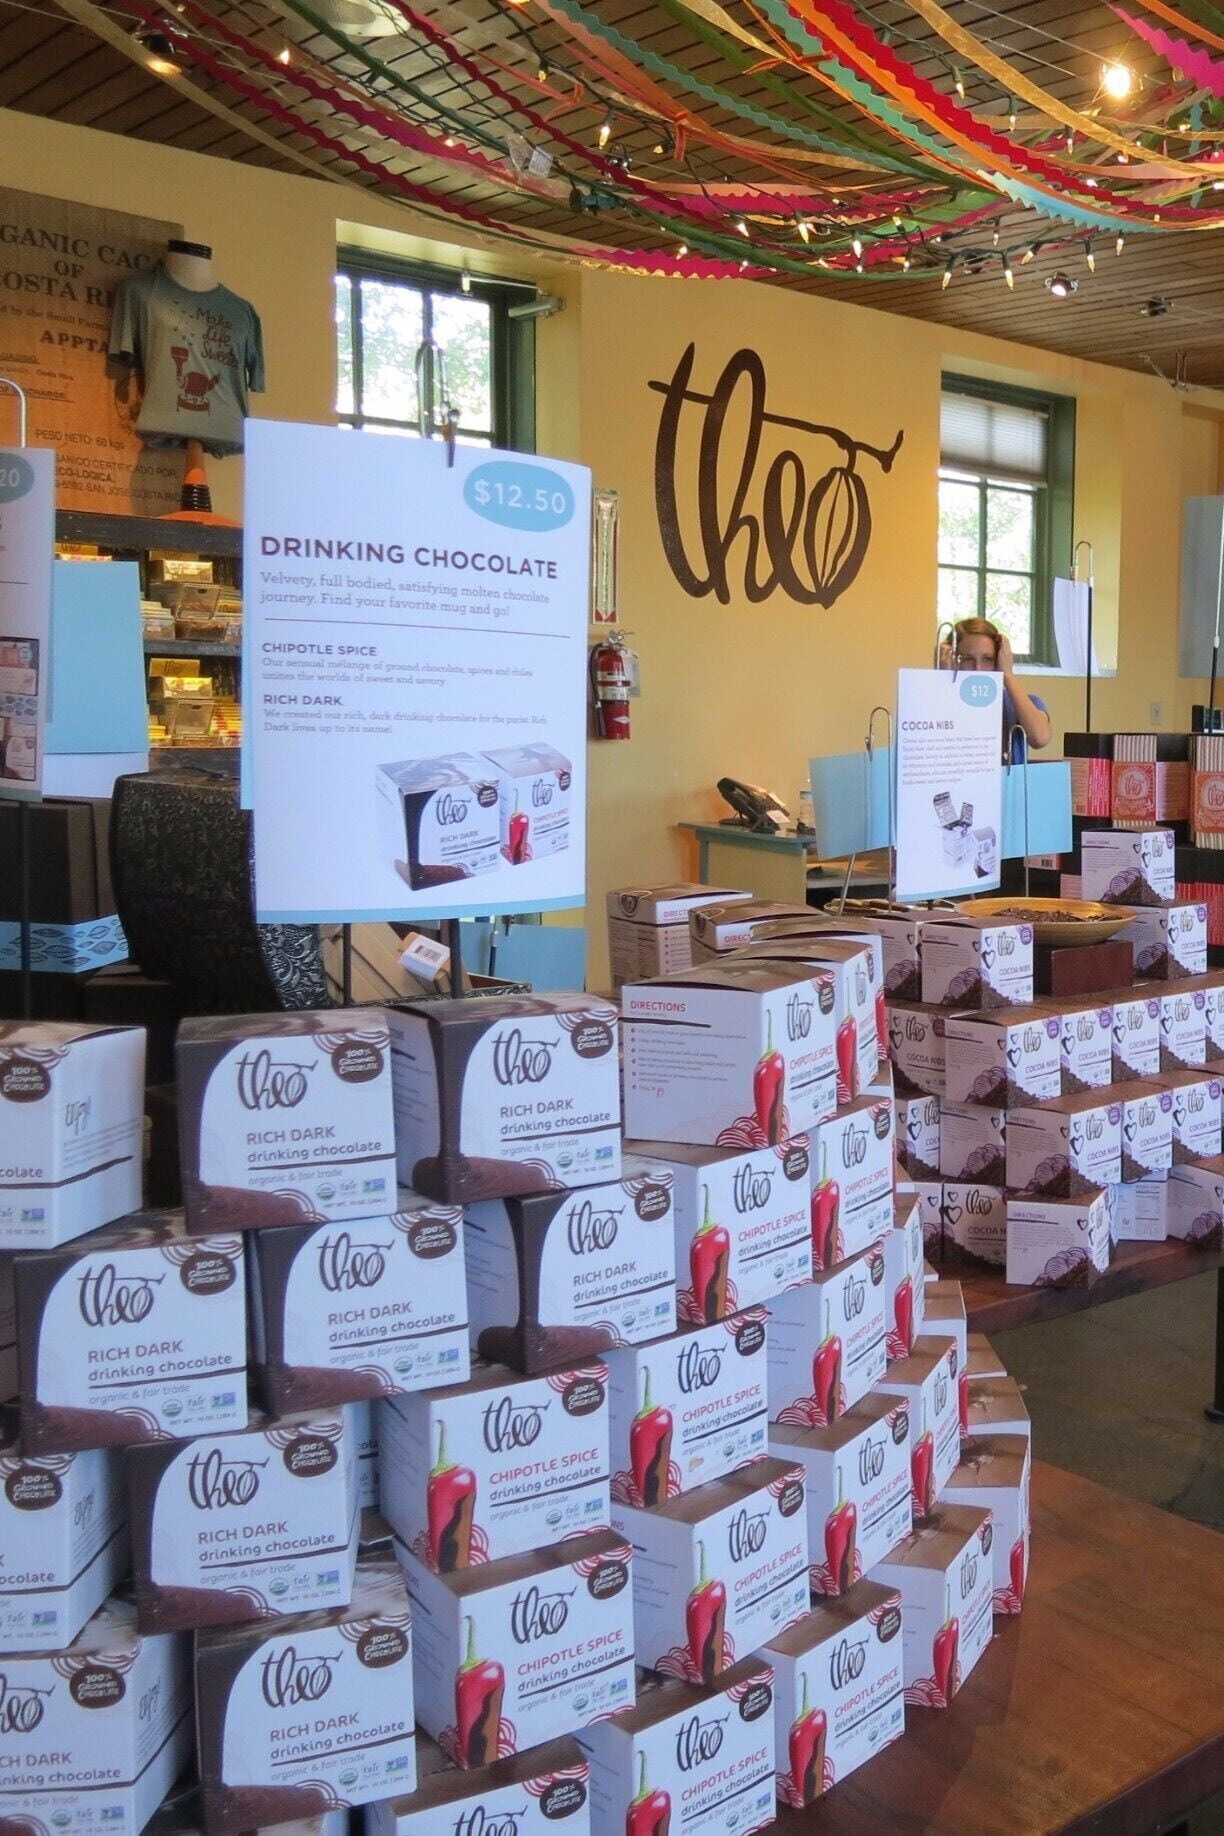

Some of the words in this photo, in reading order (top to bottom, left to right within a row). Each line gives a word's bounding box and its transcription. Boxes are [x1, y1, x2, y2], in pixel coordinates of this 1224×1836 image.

[0, 224, 89, 258] GANIC
[97, 244, 166, 273] CACA
[54, 260, 85, 278] OF
[2, 271, 79, 302] OSTA
[196, 307, 232, 330] Make
[202, 326, 231, 348] Life
[35, 429, 60, 440] PESO
[647, 342, 904, 610] theo
[475, 479, 566, 514] $12.50
[261, 536, 404, 564] DRINKING
[414, 547, 557, 579] CHOCOLATE
[260, 571, 316, 588] Velvety,
[320, 574, 342, 587] full
[347, 576, 395, 591] bodied,
[398, 581, 458, 597] satisfying
[460, 586, 500, 598] molten
[503, 589, 550, 603] chocolate
[260, 590, 317, 606] journey.
[320, 593, 352, 605] Find
[355, 597, 385, 609] your
[389, 596, 437, 610] favorite
[440, 603, 466, 615] mug
[469, 604, 490, 615] and
[493, 606, 510, 617] go!
[262, 642, 333, 655] CHIPOTLE
[338, 645, 377, 656] SPICE
[262, 658, 282, 667] Our
[286, 659, 325, 668] sensual
[372, 661, 384, 670] of
[385, 662, 420, 672] ground
[468, 666, 493, 676] spices
[495, 667, 509, 676] and
[297, 671, 314, 681] the
[316, 672, 351, 682] worlds
[353, 673, 364, 682] of
[366, 675, 394, 683] sweet
[395, 675, 414, 684] and
[415, 678, 445, 687] savory
[263, 694, 298, 704] RICH
[302, 695, 343, 705] DARK
[971, 685, 989, 698] $12
[263, 709, 282, 718] We
[283, 709, 321, 719] created
[323, 711, 341, 719] our
[343, 710, 367, 721] rich,
[369, 711, 391, 721] dark
[393, 712, 433, 723] drinking
[435, 712, 477, 722] chocolate
[479, 713, 491, 722] for
[491, 714, 505, 723] the
[263, 722, 290, 732] Dark
[292, 722, 317, 732] lives
[320, 725, 332, 734] up
[335, 724, 346, 732] to
[347, 724, 361, 733] its
[901, 720, 935, 731] COCOA
[936, 720, 954, 731] NIBS
[630, 1001, 687, 1012] DIRECTIONS
[905, 1016, 929, 1043] theo
[1023, 1027, 1043, 1053] theo
[491, 1029, 560, 1086] theo
[907, 1053, 929, 1062] COCOA
[930, 1056, 945, 1066] NIBS
[1025, 1064, 1045, 1074] COCOA
[1046, 1059, 1058, 1070] NIBS
[236, 1050, 318, 1110] theo
[500, 1104, 532, 1118] RICH
[537, 1099, 573, 1114] DARK
[501, 1120, 551, 1135] drinking
[555, 1113, 611, 1128] chocolate
[247, 1130, 285, 1145] RICH
[291, 1126, 335, 1141] DARK
[248, 1147, 309, 1162] drinking
[313, 1141, 382, 1157] chocolate
[733, 1163, 776, 1214] theo
[567, 1200, 626, 1256] theo
[738, 1219, 781, 1242] CHIPOTLE
[783, 1210, 807, 1227] SPICE
[738, 1238, 771, 1256] drinking
[773, 1225, 808, 1245] chocolate
[187, 1267, 227, 1278] GROUND
[194, 1259, 223, 1269] 100%
[317, 1232, 395, 1292] theo
[573, 1270, 602, 1286] RICH
[605, 1261, 637, 1279] DARK
[78, 1264, 166, 1327] theo
[188, 1275, 230, 1287] CHOCOLATE
[573, 1282, 618, 1302] drinking
[620, 1270, 668, 1290] chocolate
[328, 1310, 365, 1326] RICH
[370, 1301, 413, 1319] DARK
[329, 1324, 388, 1343] drinking
[391, 1313, 456, 1333] chocolate
[88, 1347, 130, 1363] RICH
[135, 1340, 183, 1358] DARK
[88, 1365, 155, 1381] drinking
[159, 1354, 232, 1373] chocolate
[678, 1341, 727, 1394] theo
[683, 1396, 732, 1422] CHIPOTLE
[735, 1384, 761, 1402] SPICE
[683, 1416, 720, 1437] drinking
[723, 1400, 763, 1421] chocolate
[482, 1396, 551, 1453] theo
[187, 1449, 270, 1510] theo
[489, 1458, 557, 1485] CHIPOTLE
[562, 1448, 599, 1468] SPICE
[490, 1481, 541, 1500] drinking
[544, 1466, 601, 1487] chocolate
[198, 1530, 237, 1544] RICH
[243, 1521, 288, 1538] DARK
[199, 1544, 261, 1562] drinking
[265, 1534, 335, 1553] chocolate
[727, 1506, 771, 1563] theo
[735, 1560, 776, 1592] CHIPOTLE
[779, 1544, 802, 1565] SPICE
[735, 1582, 768, 1607] drinking
[769, 1559, 804, 1585] chocolate
[510, 1586, 577, 1644] theo
[518, 1646, 582, 1677] CHIPOTLE
[587, 1630, 623, 1651] SPICE
[518, 1669, 568, 1692] drinking
[571, 1646, 625, 1673] chocolate
[829, 1637, 871, 1692] theo
[260, 1646, 343, 1709] theo
[834, 1688, 874, 1719] CHIPOTLE
[875, 1667, 899, 1692] SPICE
[270, 1725, 309, 1743] RICH
[315, 1712, 359, 1733] DARK
[270, 1739, 332, 1760] drinking
[337, 1720, 406, 1745] chocolate
[676, 1711, 730, 1772] theo
[681, 1766, 736, 1801] CHIPOTLE
[738, 1747, 768, 1771] SPICE
[682, 1789, 723, 1817] drinking
[725, 1762, 769, 1791] chocolate
